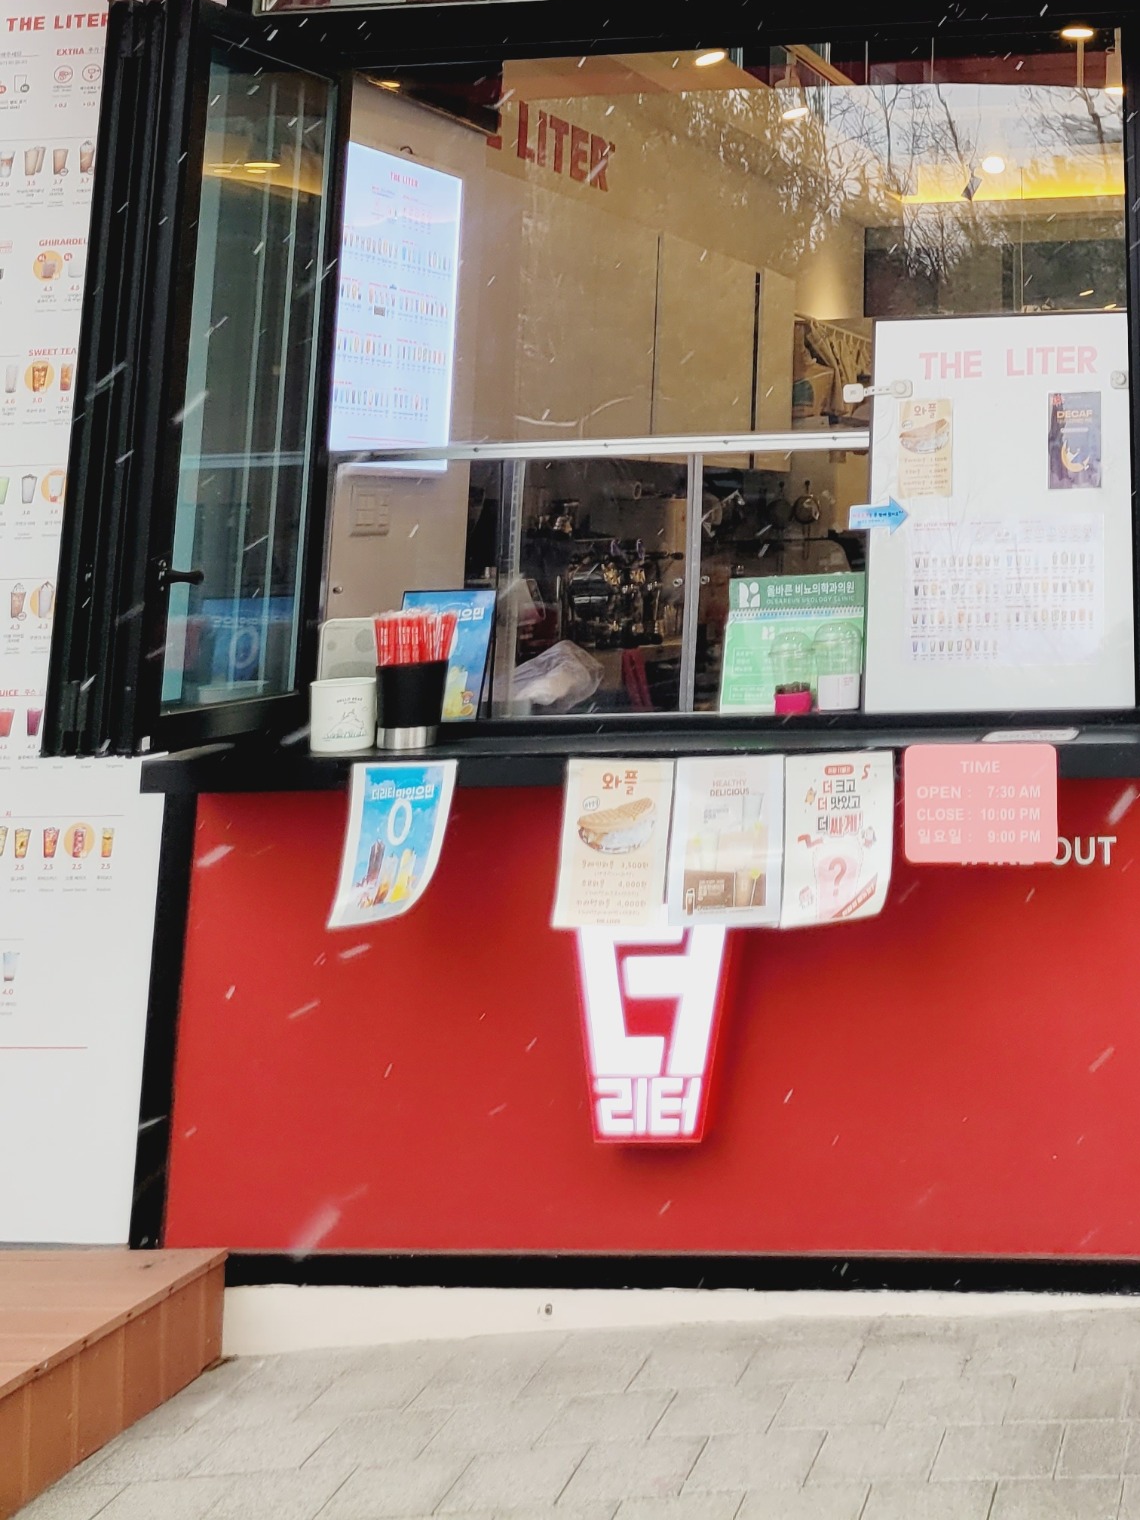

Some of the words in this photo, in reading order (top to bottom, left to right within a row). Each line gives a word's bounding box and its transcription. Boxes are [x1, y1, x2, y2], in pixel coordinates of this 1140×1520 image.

[6, 16, 45, 32] THE
[919, 351, 982, 380] THE
[1006, 346, 1098, 377] LITER
[1056, 409, 1093, 419] DECAF
[767, 584, 794, 597] 올바른
[795, 581, 855, 595] 비뇨의학과의원
[960, 760, 1000, 773] TIME
[602, 770, 638, 795] 와플
[822, 781, 832, 794] 더
[835, 779, 856, 793] 크고
[710, 788, 749, 797] DELICIOUS
[916, 786, 962, 799] OPEN
[987, 786, 1015, 798] 7:30
[1019, 785, 1041, 798] AM
[817, 797, 828, 811] 더
[831, 795, 861, 810] 맛있고
[916, 808, 964, 821] CLOSE
[981, 808, 1015, 820] 10:00
[1020, 808, 1041, 820] PM
[817, 816, 829, 832] 더
[917, 828, 962, 845] 일요일
[987, 830, 1015, 843] 9:00
[1020, 830, 1041, 843] PM
[1052, 836, 1117, 866] OUT
[596, 1077, 701, 1136] 리터
